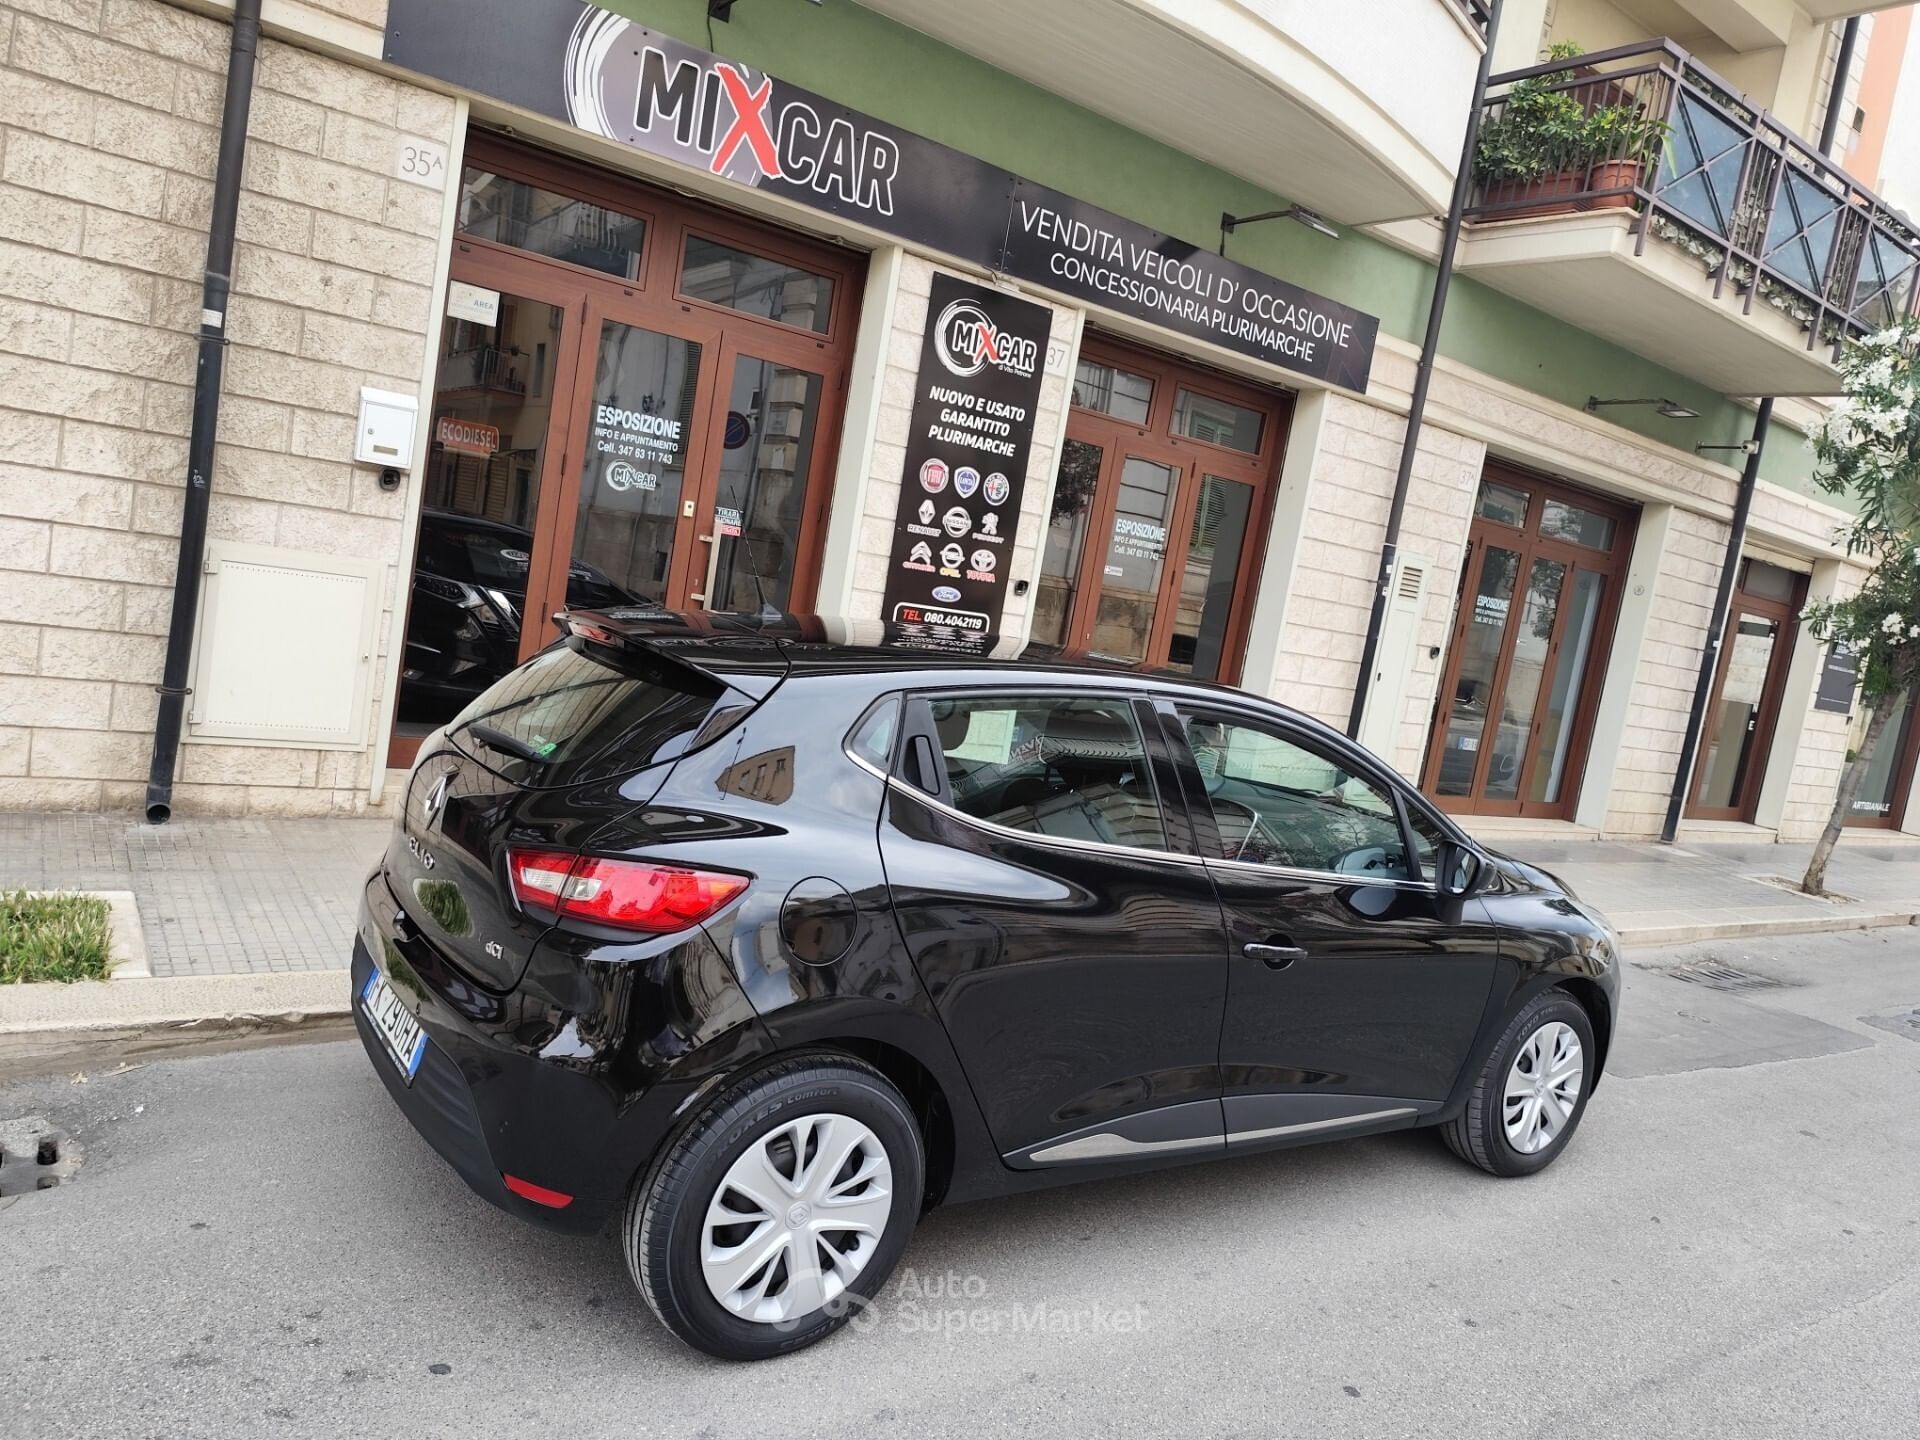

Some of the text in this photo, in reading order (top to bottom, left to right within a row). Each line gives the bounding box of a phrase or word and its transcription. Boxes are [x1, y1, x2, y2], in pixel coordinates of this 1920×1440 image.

[633, 46, 899, 216] MIXCAR
[1021, 200, 1124, 266] VENDITA
[1130, 244, 1211, 297] VEICOLI
[1242, 288, 1352, 348] OCCASIONE
[1051, 253, 1315, 363] CONCESSIONARIA PLURIMARCHE
[952, 320, 1037, 372] MIXCAR
[1047, 347, 1065, 368] 37
[929, 386, 1025, 422] NUOVO E USATO
[441, 421, 496, 450] ECODIESEL
[597, 405, 681, 439] ESPOSIZIONE
[940, 409, 1010, 437] GARANTITO
[595, 427, 679, 452] INFO E APPUNTAMENTO
[597, 441, 673, 464] Cell. 347 63 11 743
[928, 425, 1016, 457] PLURIMARCHE
[614, 467, 656, 487] MIXCAR
[1115, 519, 1166, 541] ESPOSIZIONE
[924, 612, 982, 629] 080.4042119
[409, 836, 435, 869] CLIO
